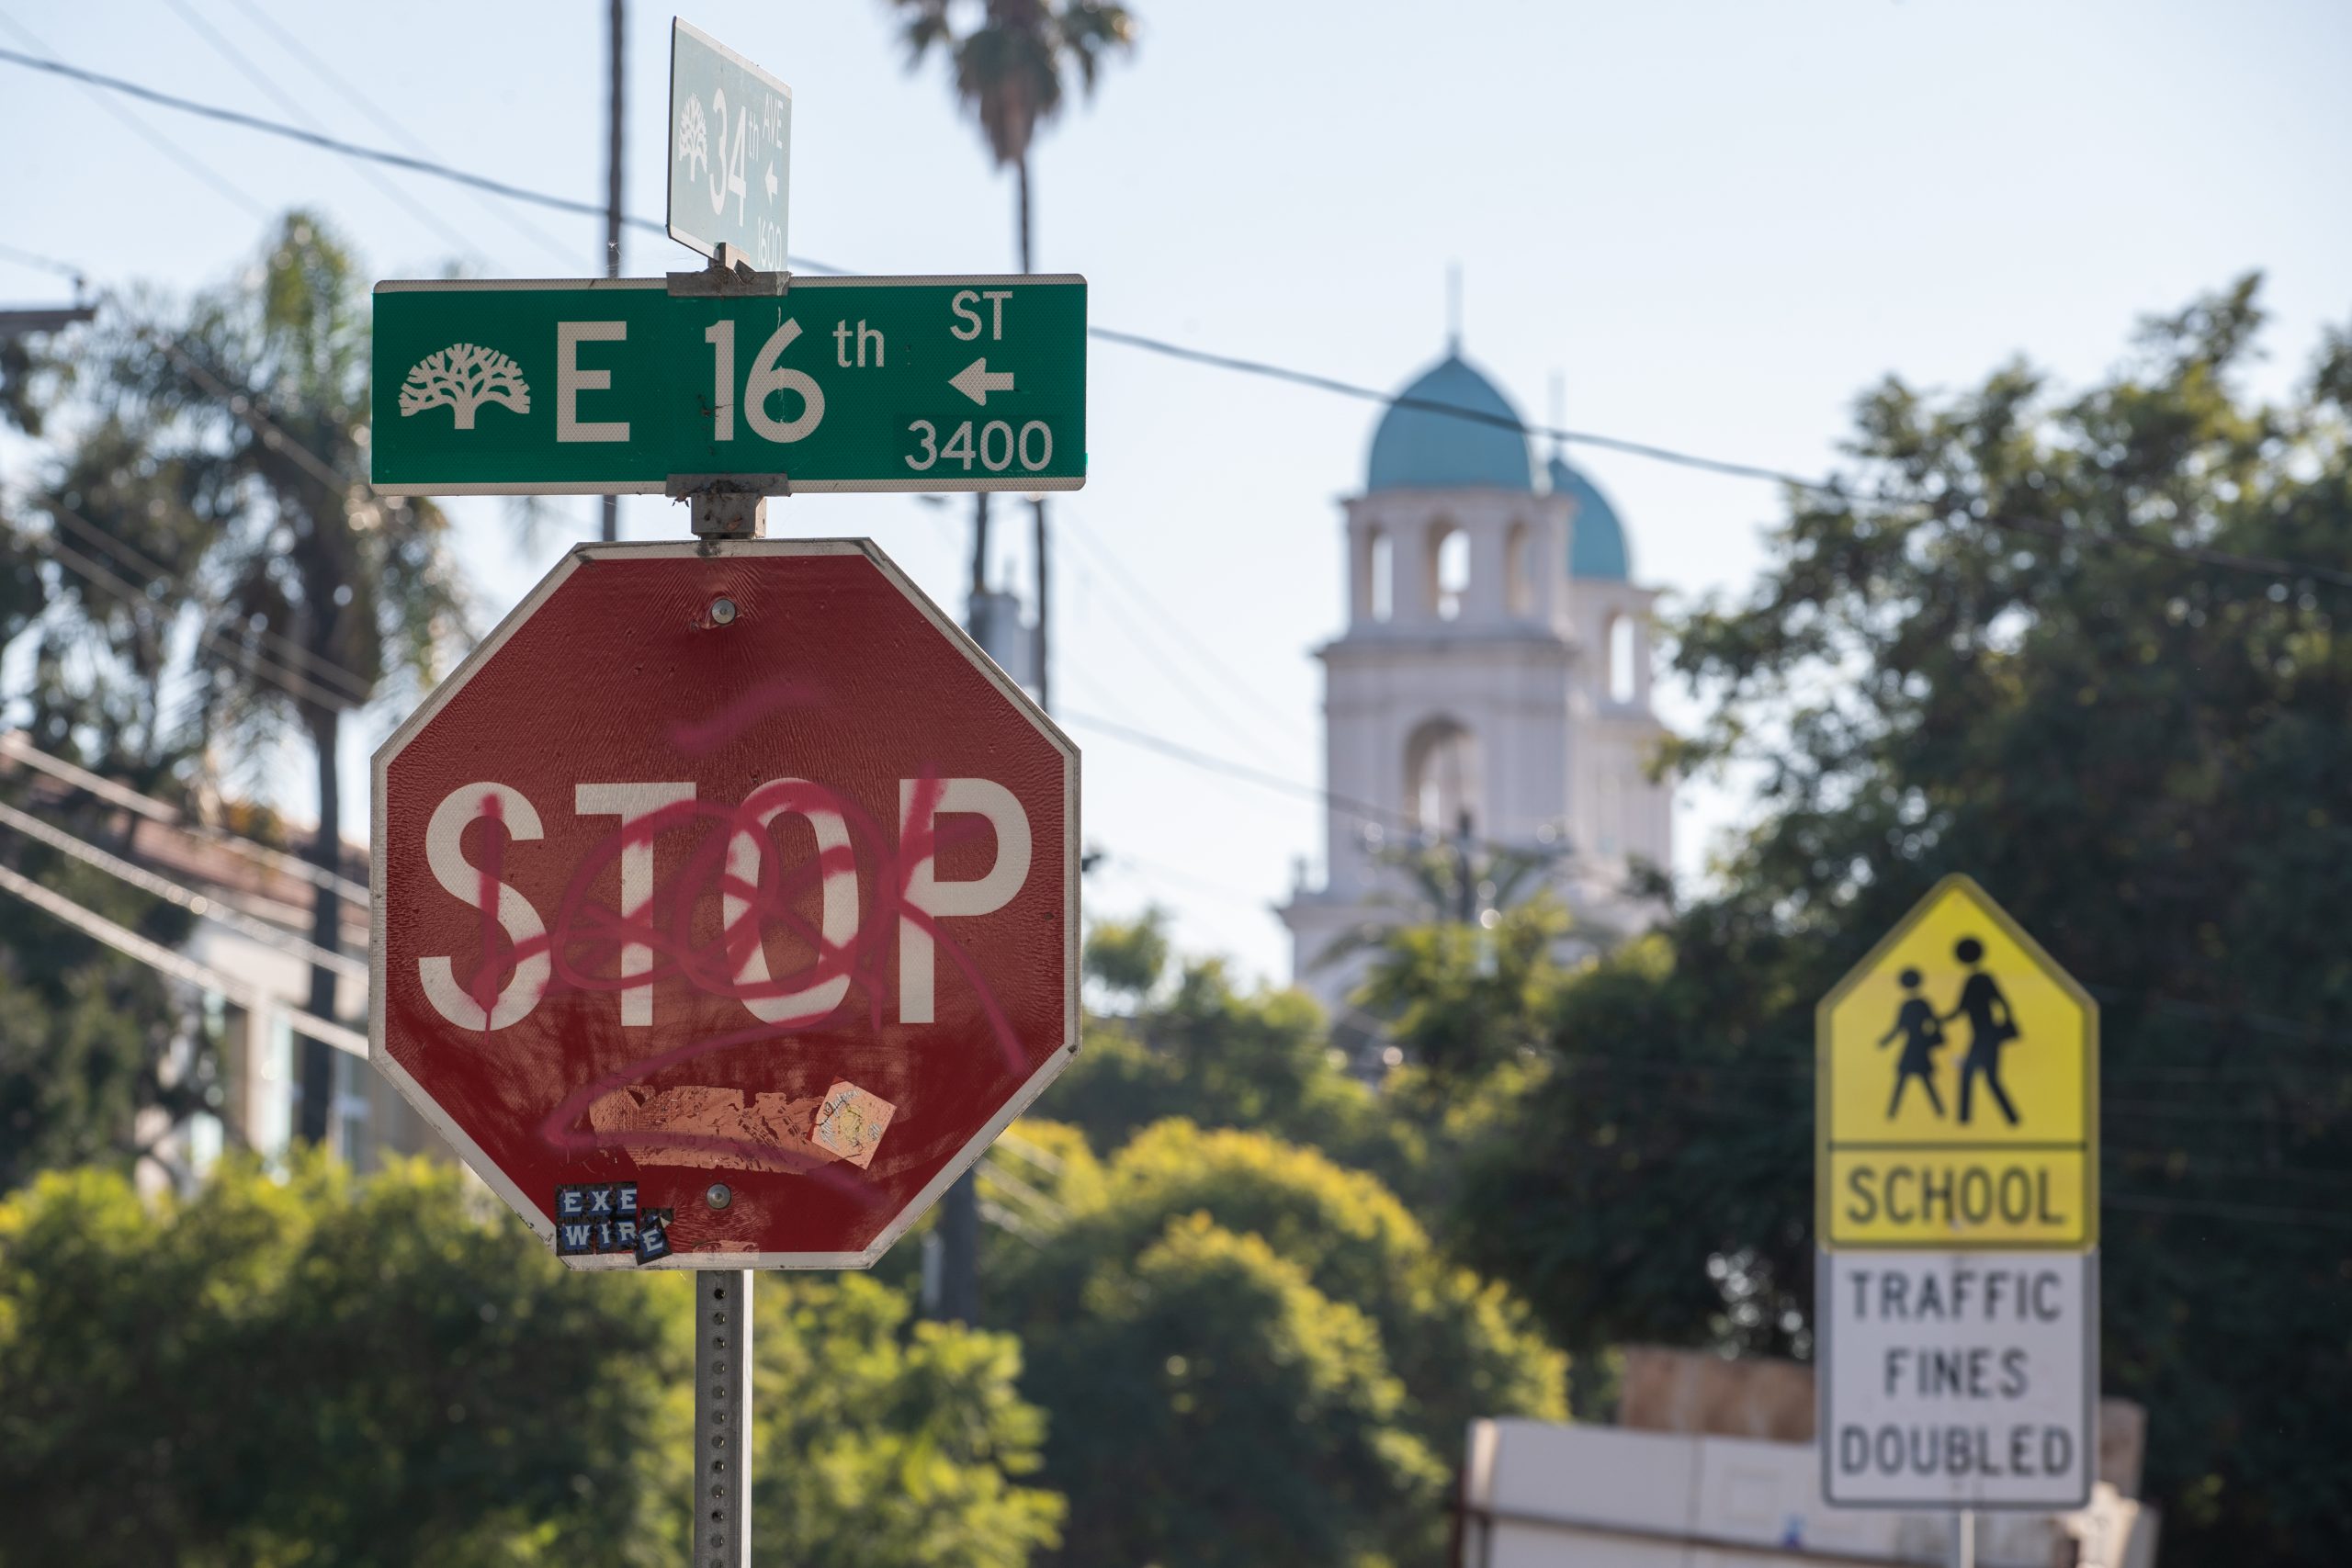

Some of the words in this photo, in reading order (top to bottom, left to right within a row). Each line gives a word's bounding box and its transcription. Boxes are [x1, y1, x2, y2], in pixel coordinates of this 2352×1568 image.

[709, 87, 759, 228] 34th
[762, 92, 784, 150] AVE
[757, 216, 782, 271] 1600
[556, 321, 630, 443] E
[704, 317, 886, 444] 16th
[949, 289, 1013, 341] ST
[904, 419, 1054, 471] 3400
[417, 776, 1034, 1032] STOP
[563, 1188, 638, 1213] EXE
[1847, 1166, 2066, 1224] SCHOOL
[565, 1222, 663, 1252] WIRE
[1849, 1270, 2063, 1323] TRAFFIC
[1884, 1347, 2029, 1398] FINES
[1840, 1425, 2074, 1478] DOUBLED
